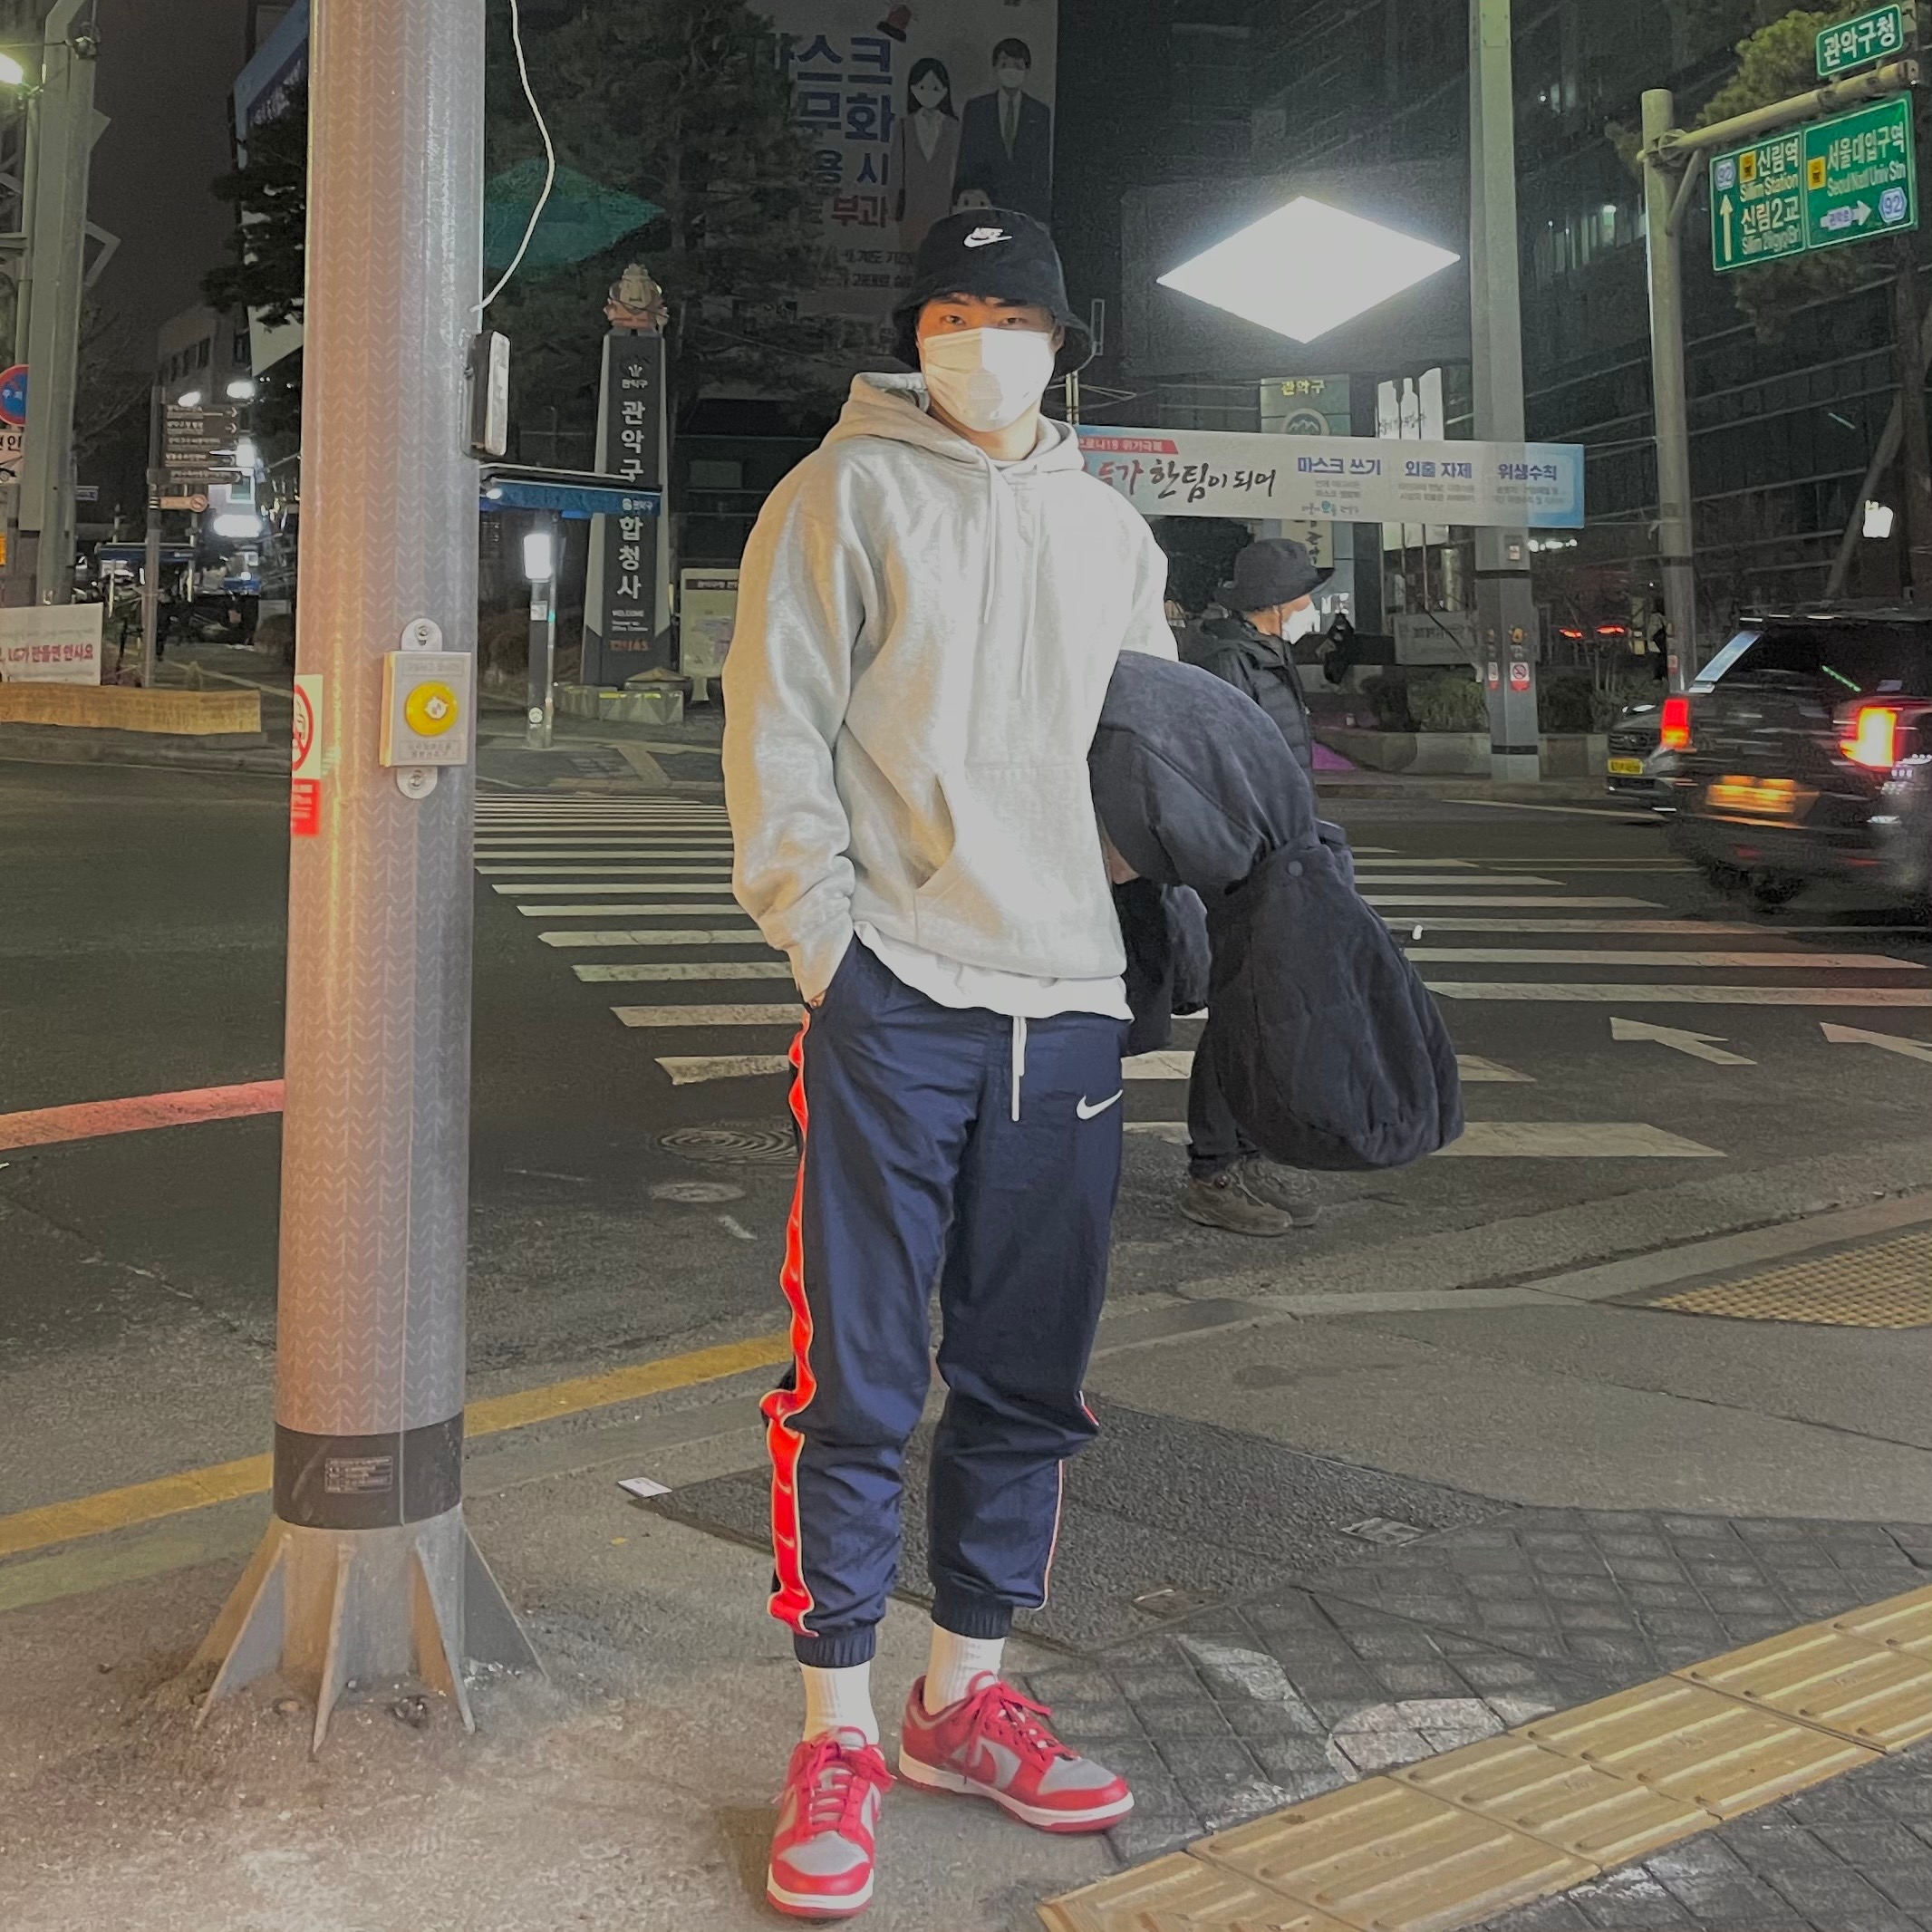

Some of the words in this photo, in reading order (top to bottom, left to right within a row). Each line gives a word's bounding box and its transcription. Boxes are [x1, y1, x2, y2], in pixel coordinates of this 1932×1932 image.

[1823, 13, 1896, 66] 관악구청
[797, 92, 895, 143] 무화
[1757, 139, 1799, 178] 신림역
[1827, 121, 1905, 172] 서울대입구역
[831, 195, 888, 227] 부과
[1740, 196, 1801, 236] 신림2교
[1884, 195, 1901, 215] 92
[1280, 379, 1326, 397] 관악구
[620, 401, 646, 483] 관악구
[1233, 469, 1277, 497] 되어
[1297, 457, 1344, 474] 마스크
[1349, 458, 1382, 476] 쓰기
[1405, 459, 1436, 478] 외출
[1441, 461, 1473, 479] 자제
[1498, 463, 1558, 481] 위생수칙
[617, 516, 644, 600] 합청사
